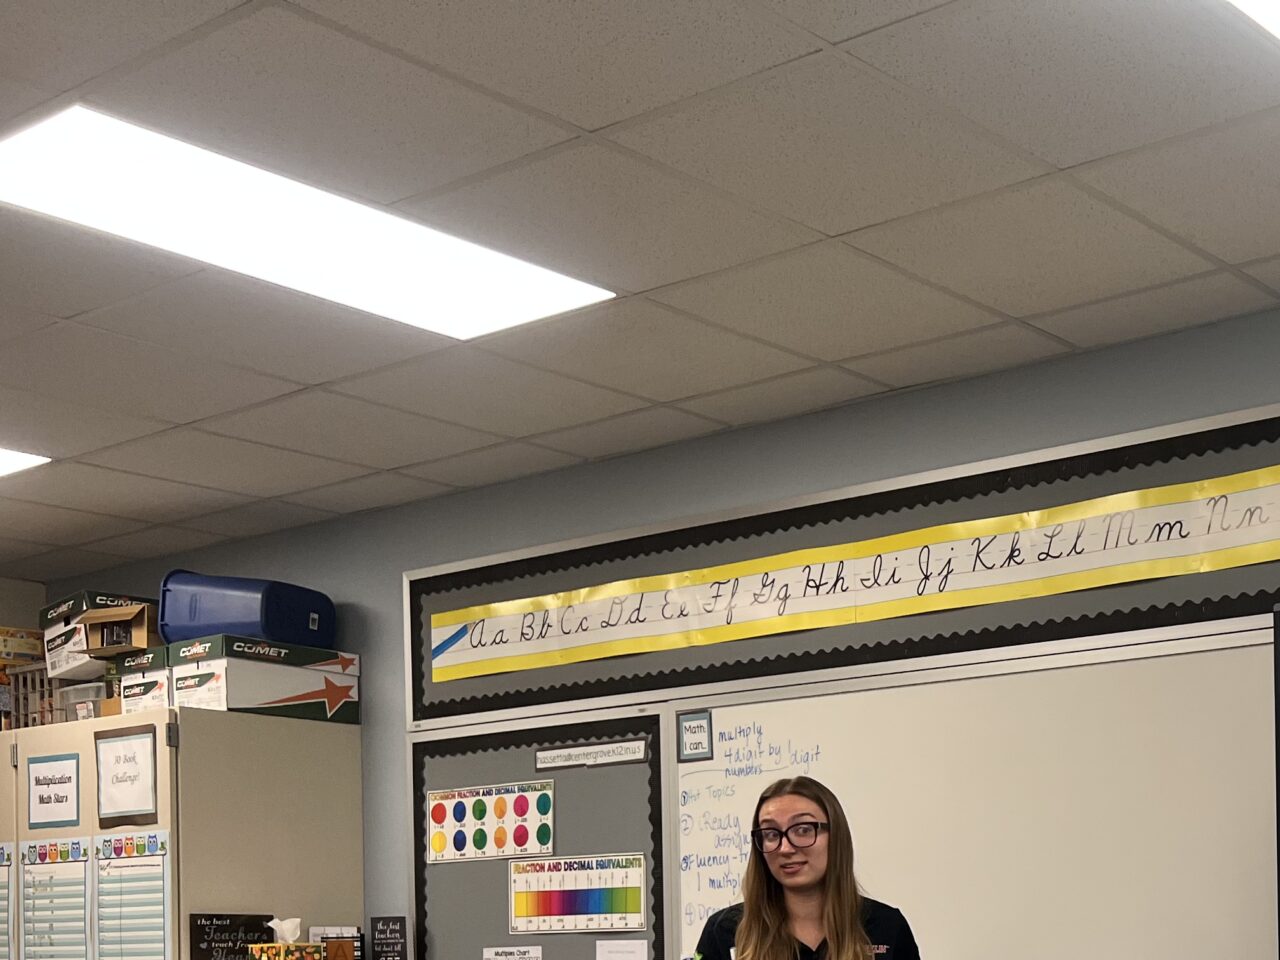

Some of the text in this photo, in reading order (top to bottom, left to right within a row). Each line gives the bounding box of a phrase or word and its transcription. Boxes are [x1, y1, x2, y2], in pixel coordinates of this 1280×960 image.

[47, 600, 75, 619] COMET
[180, 642, 212, 657] COMET
[233, 642, 289, 658] COMET
[125, 654, 154, 667] COMET
[124, 685, 145, 695] COMET
[176, 678, 200, 689] COMET
[718, 721, 763, 747] multiply
[768, 743, 782, 765] by
[790, 744, 821, 774] digit
[725, 764, 763, 778] numbers
[35, 774, 72, 788] Multiplication
[481, 787, 494, 797] AND
[494, 786, 516, 796] DECIMAL
[517, 783, 553, 794] EQUIVALENTS
[705, 785, 736, 802] Topics
[38, 794, 52, 805] Math
[703, 810, 741, 834] Ready
[513, 857, 643, 874] FRACTION AND DECIMAL EQUIVALENTS
[709, 872, 741, 896] multipl
[204, 925, 268, 941] Teachers
[516, 949, 530, 957] Chart
